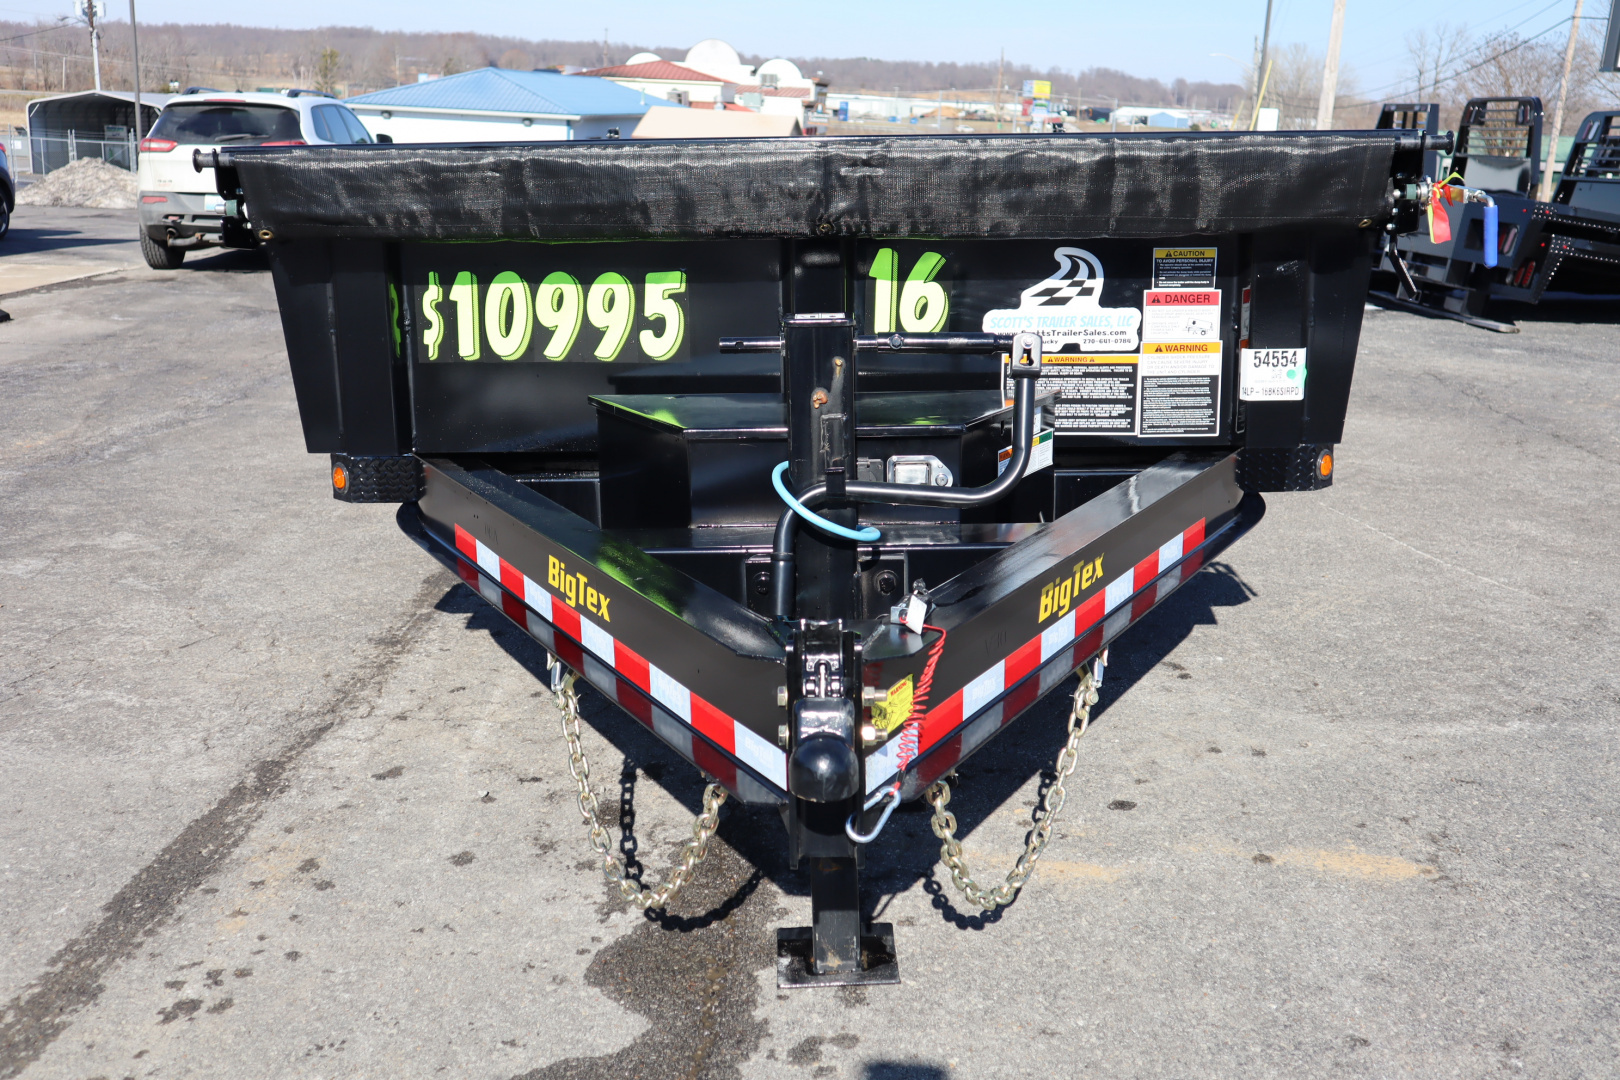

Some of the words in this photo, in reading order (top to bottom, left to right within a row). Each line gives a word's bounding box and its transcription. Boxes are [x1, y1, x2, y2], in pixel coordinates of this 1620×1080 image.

[868, 247, 949, 335] 16
[1165, 294, 1211, 304] DANGER
[422, 270, 686, 361] $10995
[990, 315, 1033, 329] SCOTT'S
[1036, 315, 1078, 328] TRAILER
[1080, 315, 1114, 329] SALES,
[1116, 314, 1135, 327] LLC
[1165, 344, 1208, 352] WARNING
[1253, 350, 1298, 368] 54554
[548, 554, 611, 622] BigTex
[1038, 552, 1105, 624] BigTex
